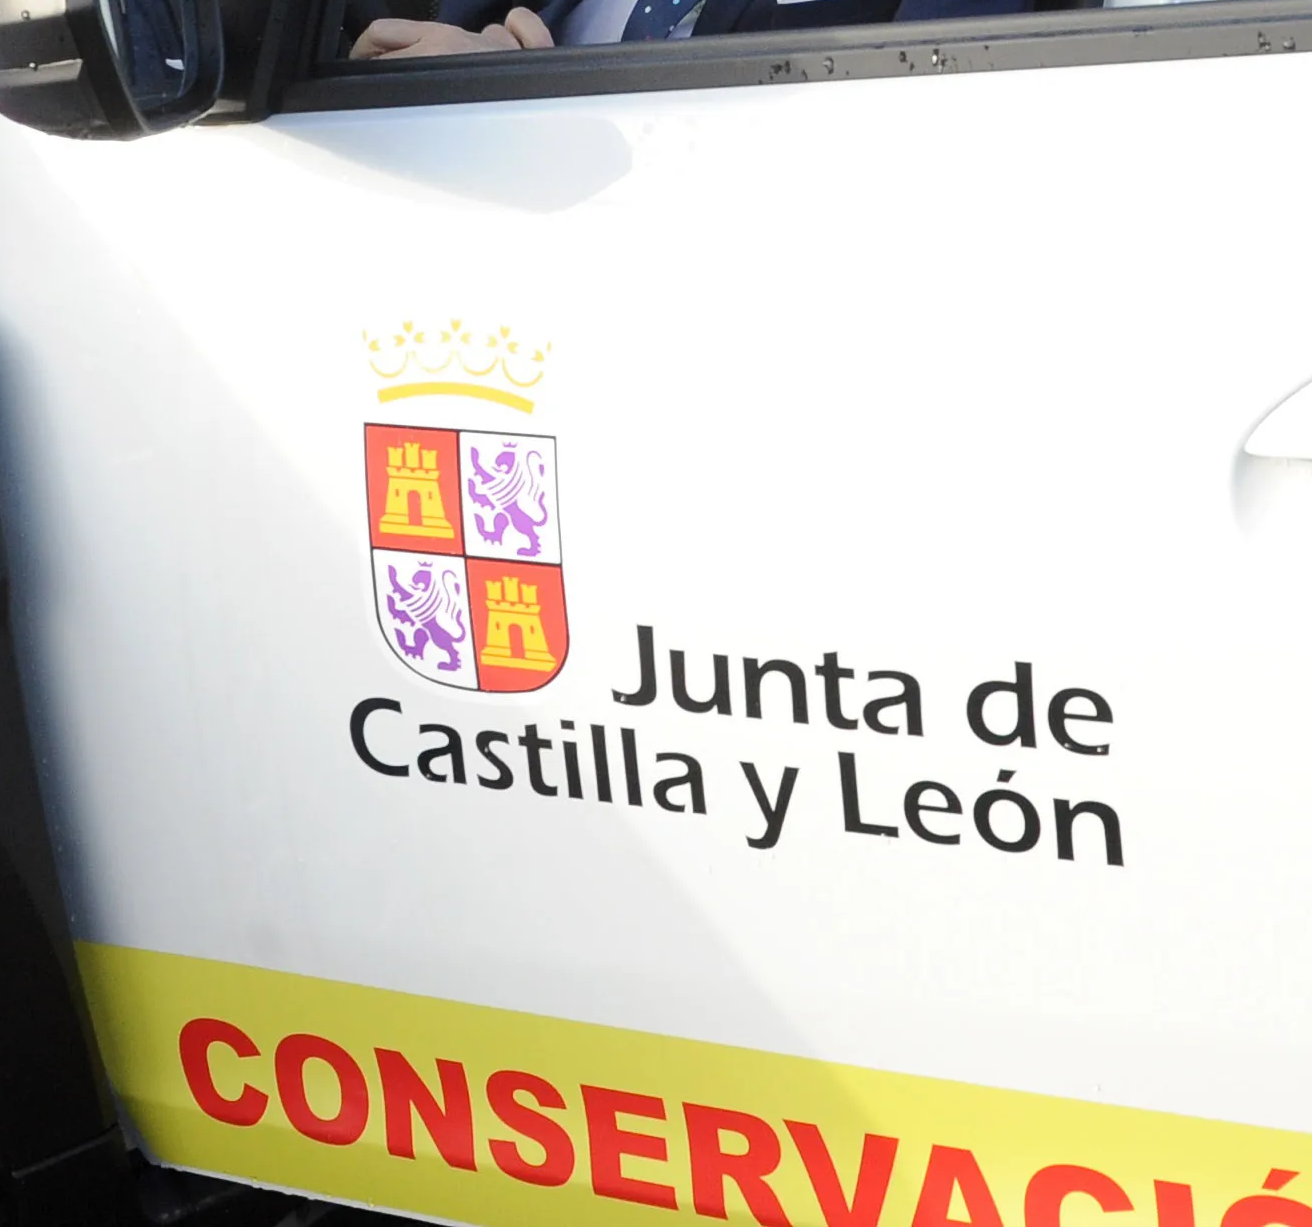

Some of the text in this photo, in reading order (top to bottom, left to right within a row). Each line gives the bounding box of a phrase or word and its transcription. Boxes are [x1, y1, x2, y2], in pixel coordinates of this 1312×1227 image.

[612, 625, 1114, 757] Junta de
[349, 697, 1125, 867] Castilla y León
